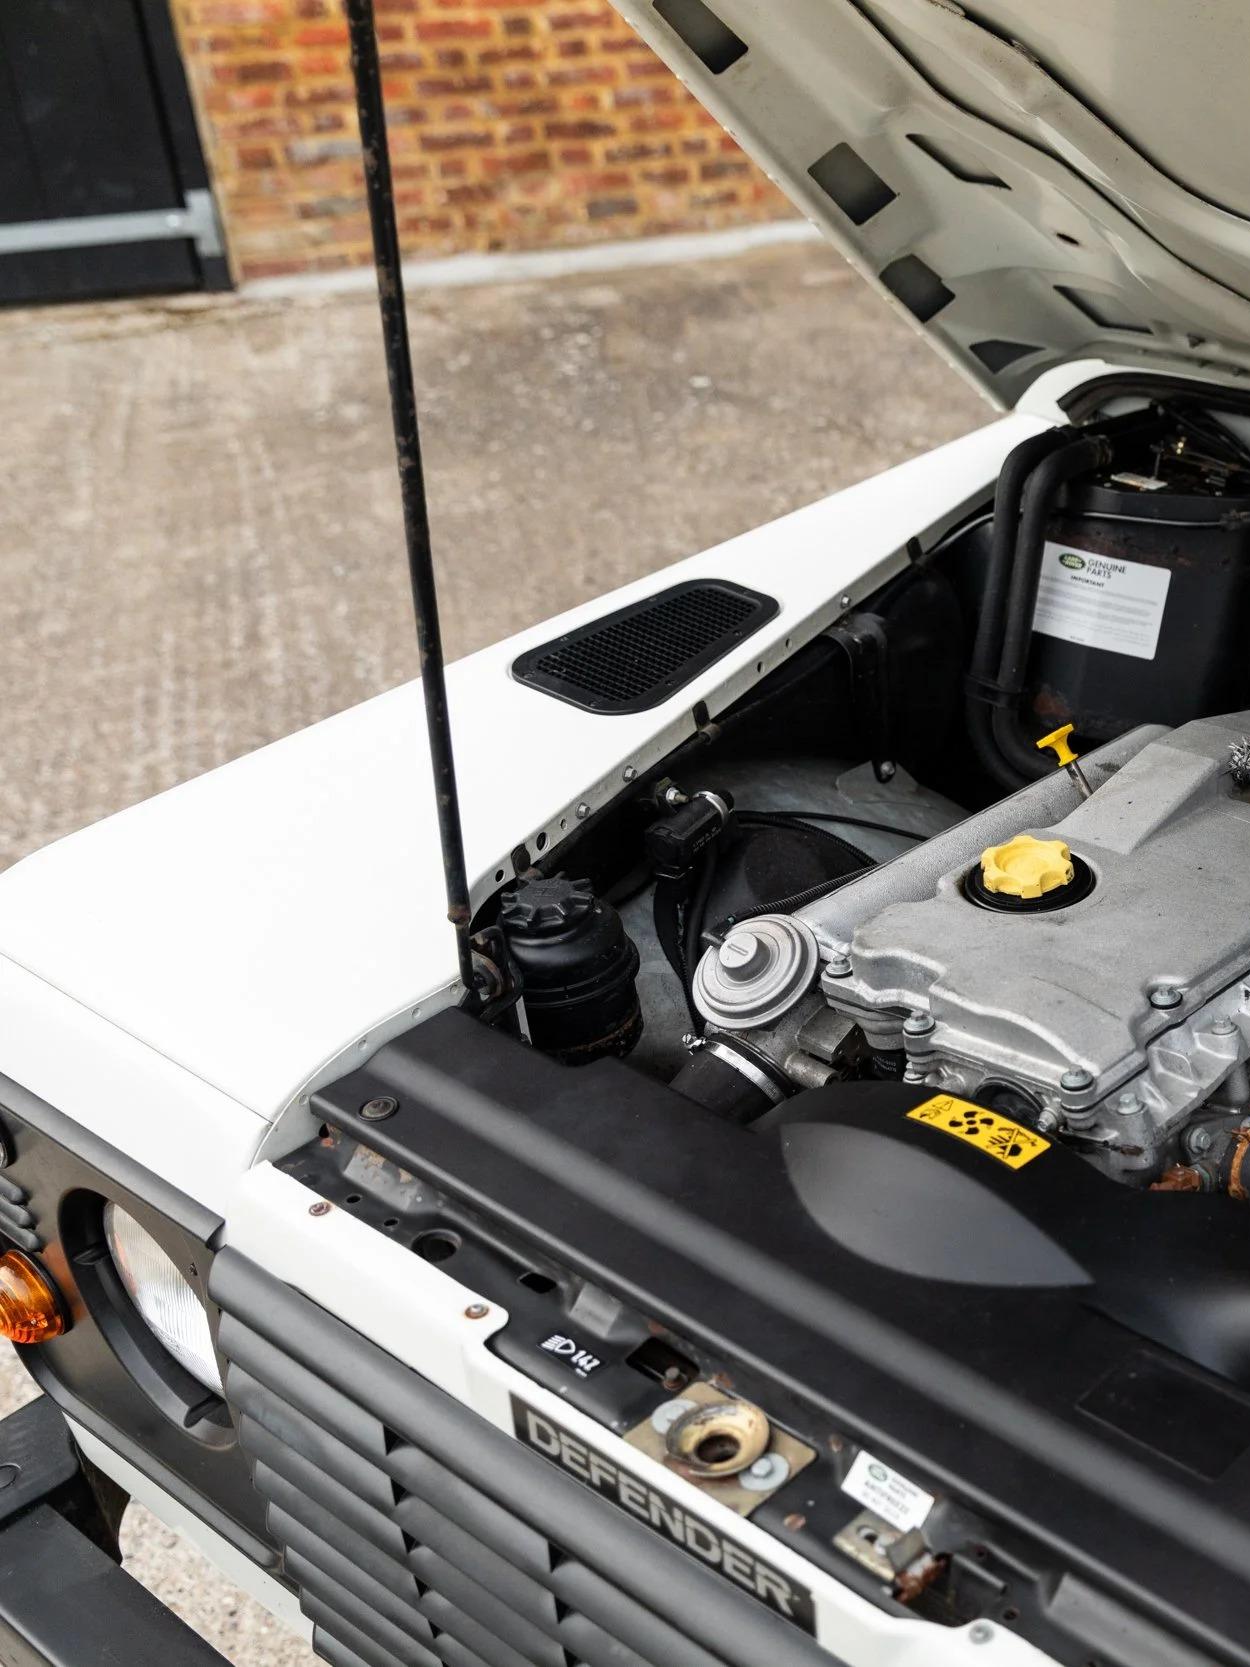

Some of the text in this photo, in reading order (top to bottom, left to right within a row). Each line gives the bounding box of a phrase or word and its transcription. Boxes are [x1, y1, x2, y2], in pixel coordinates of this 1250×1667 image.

[1086, 567, 1112, 579] PARTS
[1088, 559, 1127, 574] GENUINE
[1070, 575, 1105, 587] IMPORTANT
[527, 1409, 799, 1617] DEFENDER
